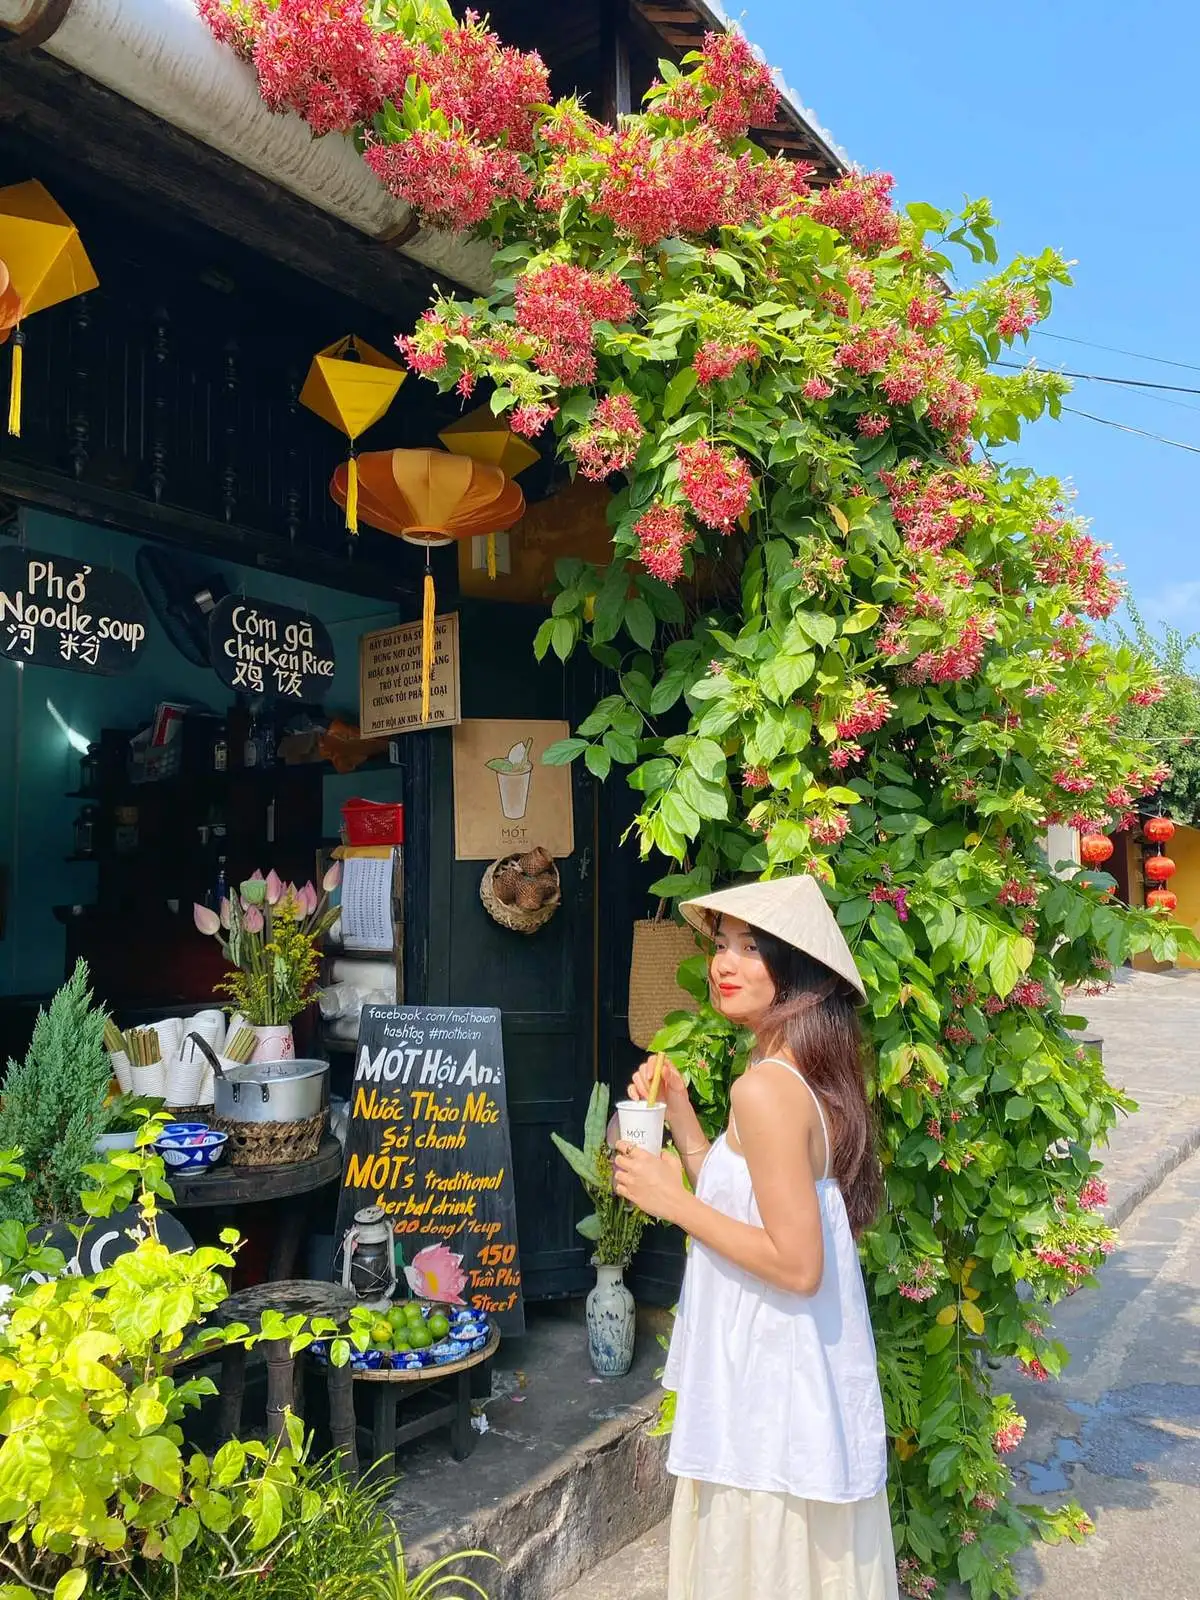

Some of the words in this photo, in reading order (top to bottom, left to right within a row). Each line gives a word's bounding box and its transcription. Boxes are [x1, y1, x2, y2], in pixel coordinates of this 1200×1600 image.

[28, 561, 92, 603] Phở
[0, 591, 92, 635] Noodle
[283, 620, 313, 652] gà
[302, 650, 334, 677] Rice
[412, 660, 422, 670] TH
[355, 1041, 423, 1084] MÓT
[419, 1049, 458, 1089] Hội
[410, 1091, 460, 1122] Thảo
[462, 1091, 500, 1129] Mộc
[414, 1122, 467, 1149] chanh
[424, 1168, 504, 1192] traditional
[376, 1193, 435, 1217] herbal
[431, 1194, 477, 1217] drink
[477, 1244, 516, 1266] 150
[469, 1267, 495, 1288] Trần
[495, 1267, 520, 1288] Phú
[471, 1291, 518, 1312] Street
